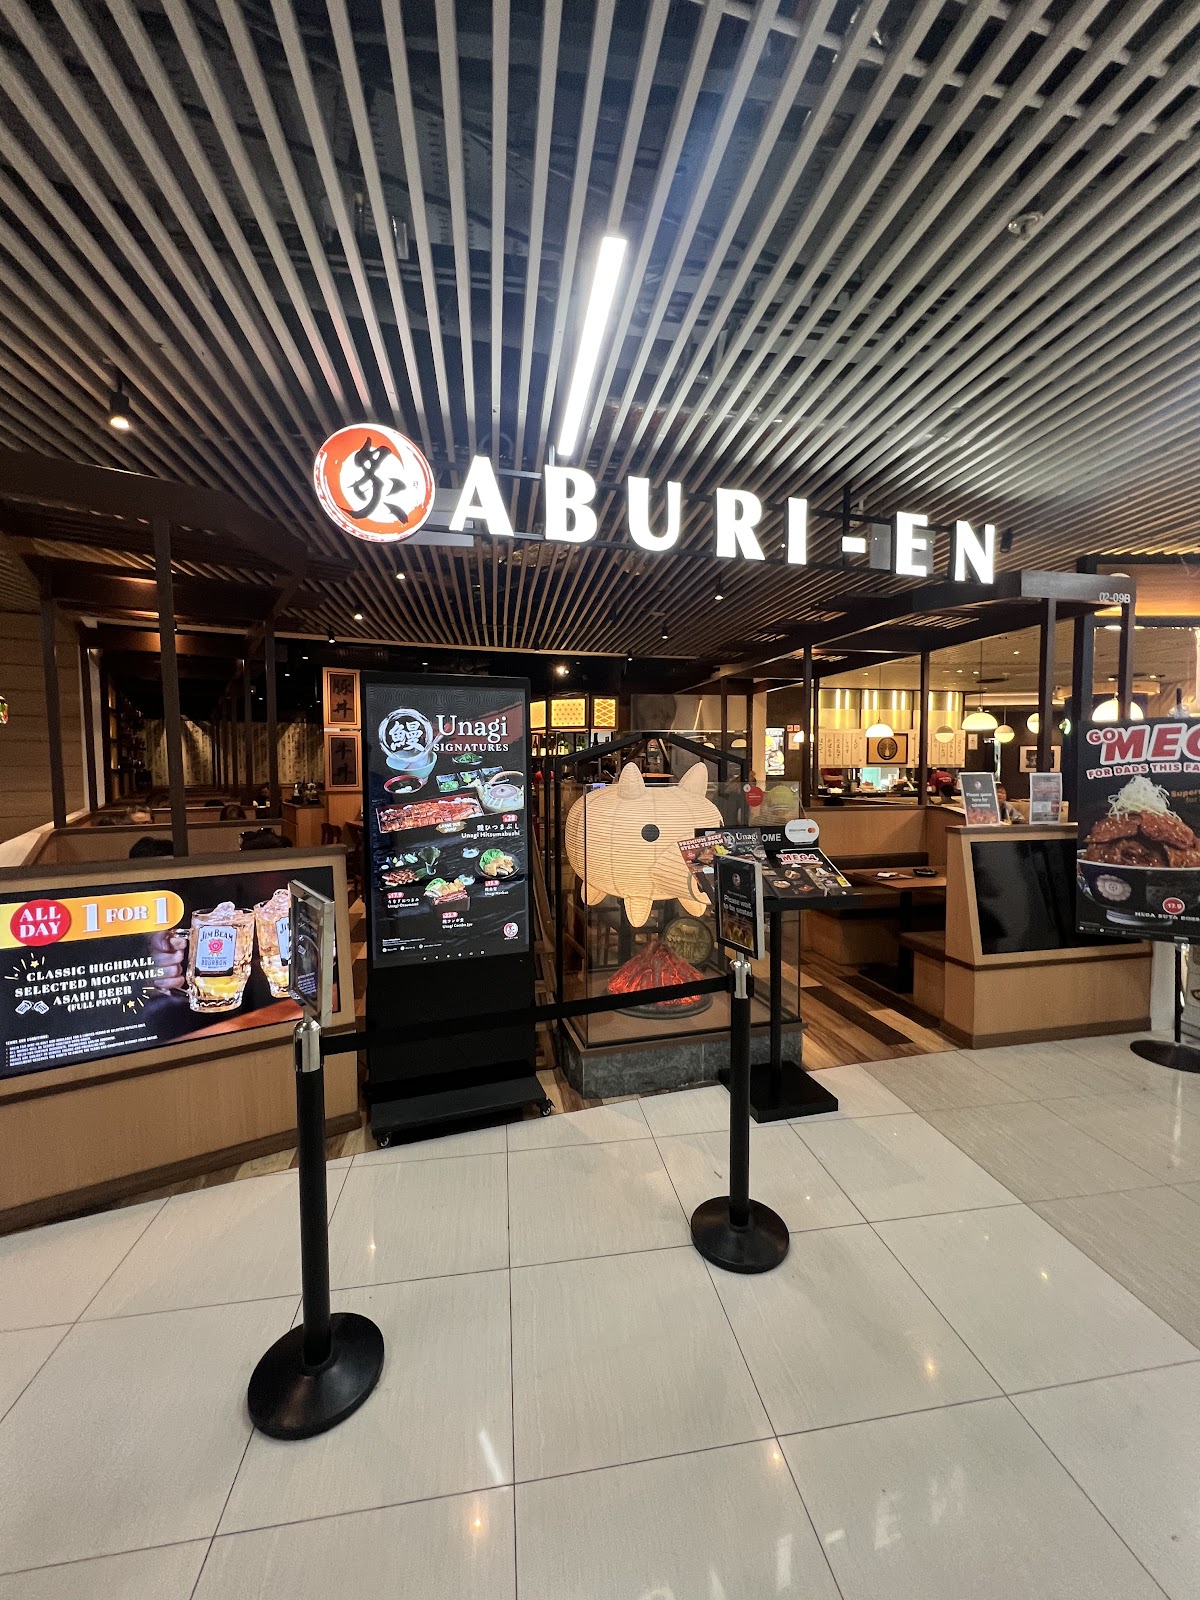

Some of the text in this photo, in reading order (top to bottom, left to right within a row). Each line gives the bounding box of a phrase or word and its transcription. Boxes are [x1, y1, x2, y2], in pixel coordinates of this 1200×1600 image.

[1099, 592, 1131, 604] 02-09B
[388, 720, 426, 752] 鰻
[436, 715, 508, 744] Unagi
[1088, 729, 1116, 743] GO
[433, 743, 509, 752] SIGNATURES
[1087, 767, 1111, 779] FOR
[1114, 764, 1147, 775] DADS
[1151, 763, 1180, 772] THIS
[461, 832, 479, 840] Unagi
[735, 832, 758, 842] Unagi
[19, 906, 61, 923] ALL
[82, 897, 170, 933] 1 FOR 1
[19, 921, 61, 939] DAY
[214, 929, 234, 941] BEAM
[26, 957, 155, 982] CLASSIC HIGHBALL
[15, 967, 165, 998] SELECTED MOCKTAILS
[53, 985, 133, 1006] ASAHI BEER
[67, 996, 121, 1013] (FULL PINT)
